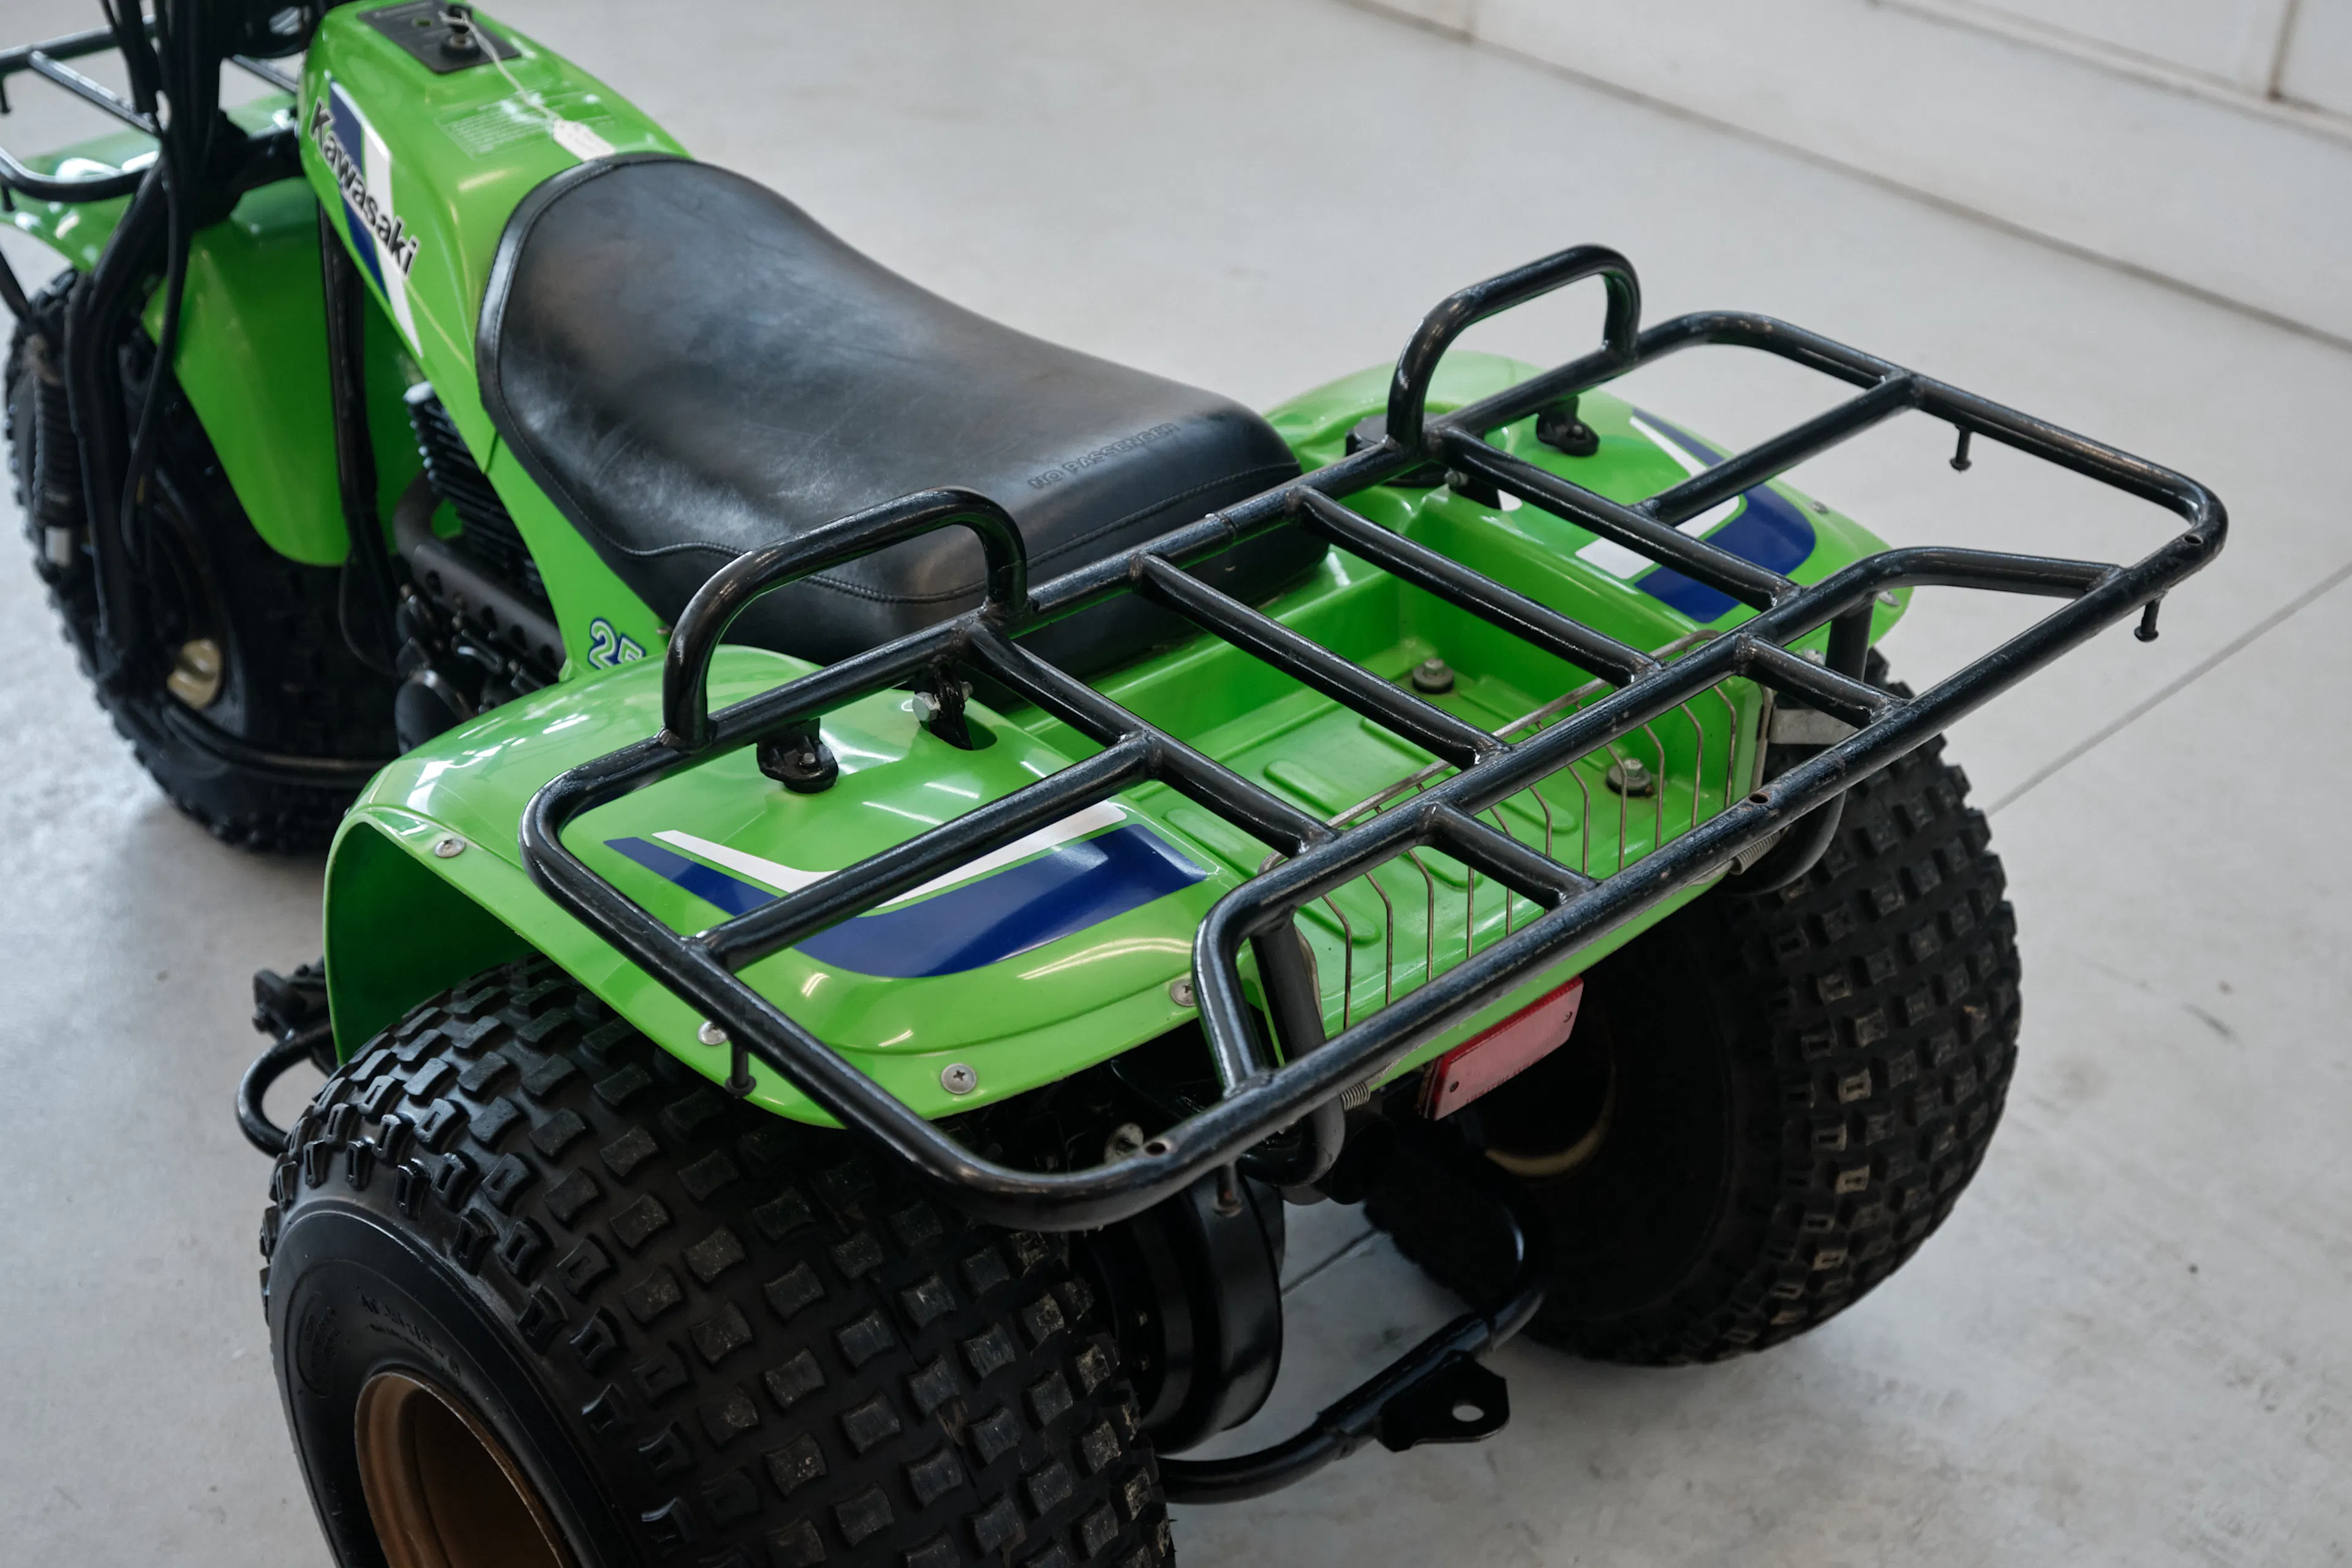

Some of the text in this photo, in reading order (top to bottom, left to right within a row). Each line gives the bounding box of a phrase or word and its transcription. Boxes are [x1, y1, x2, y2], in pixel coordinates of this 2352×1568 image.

[309, 98, 420, 278] Kawasaki
[1028, 423, 1181, 489] NO PASSENGER
